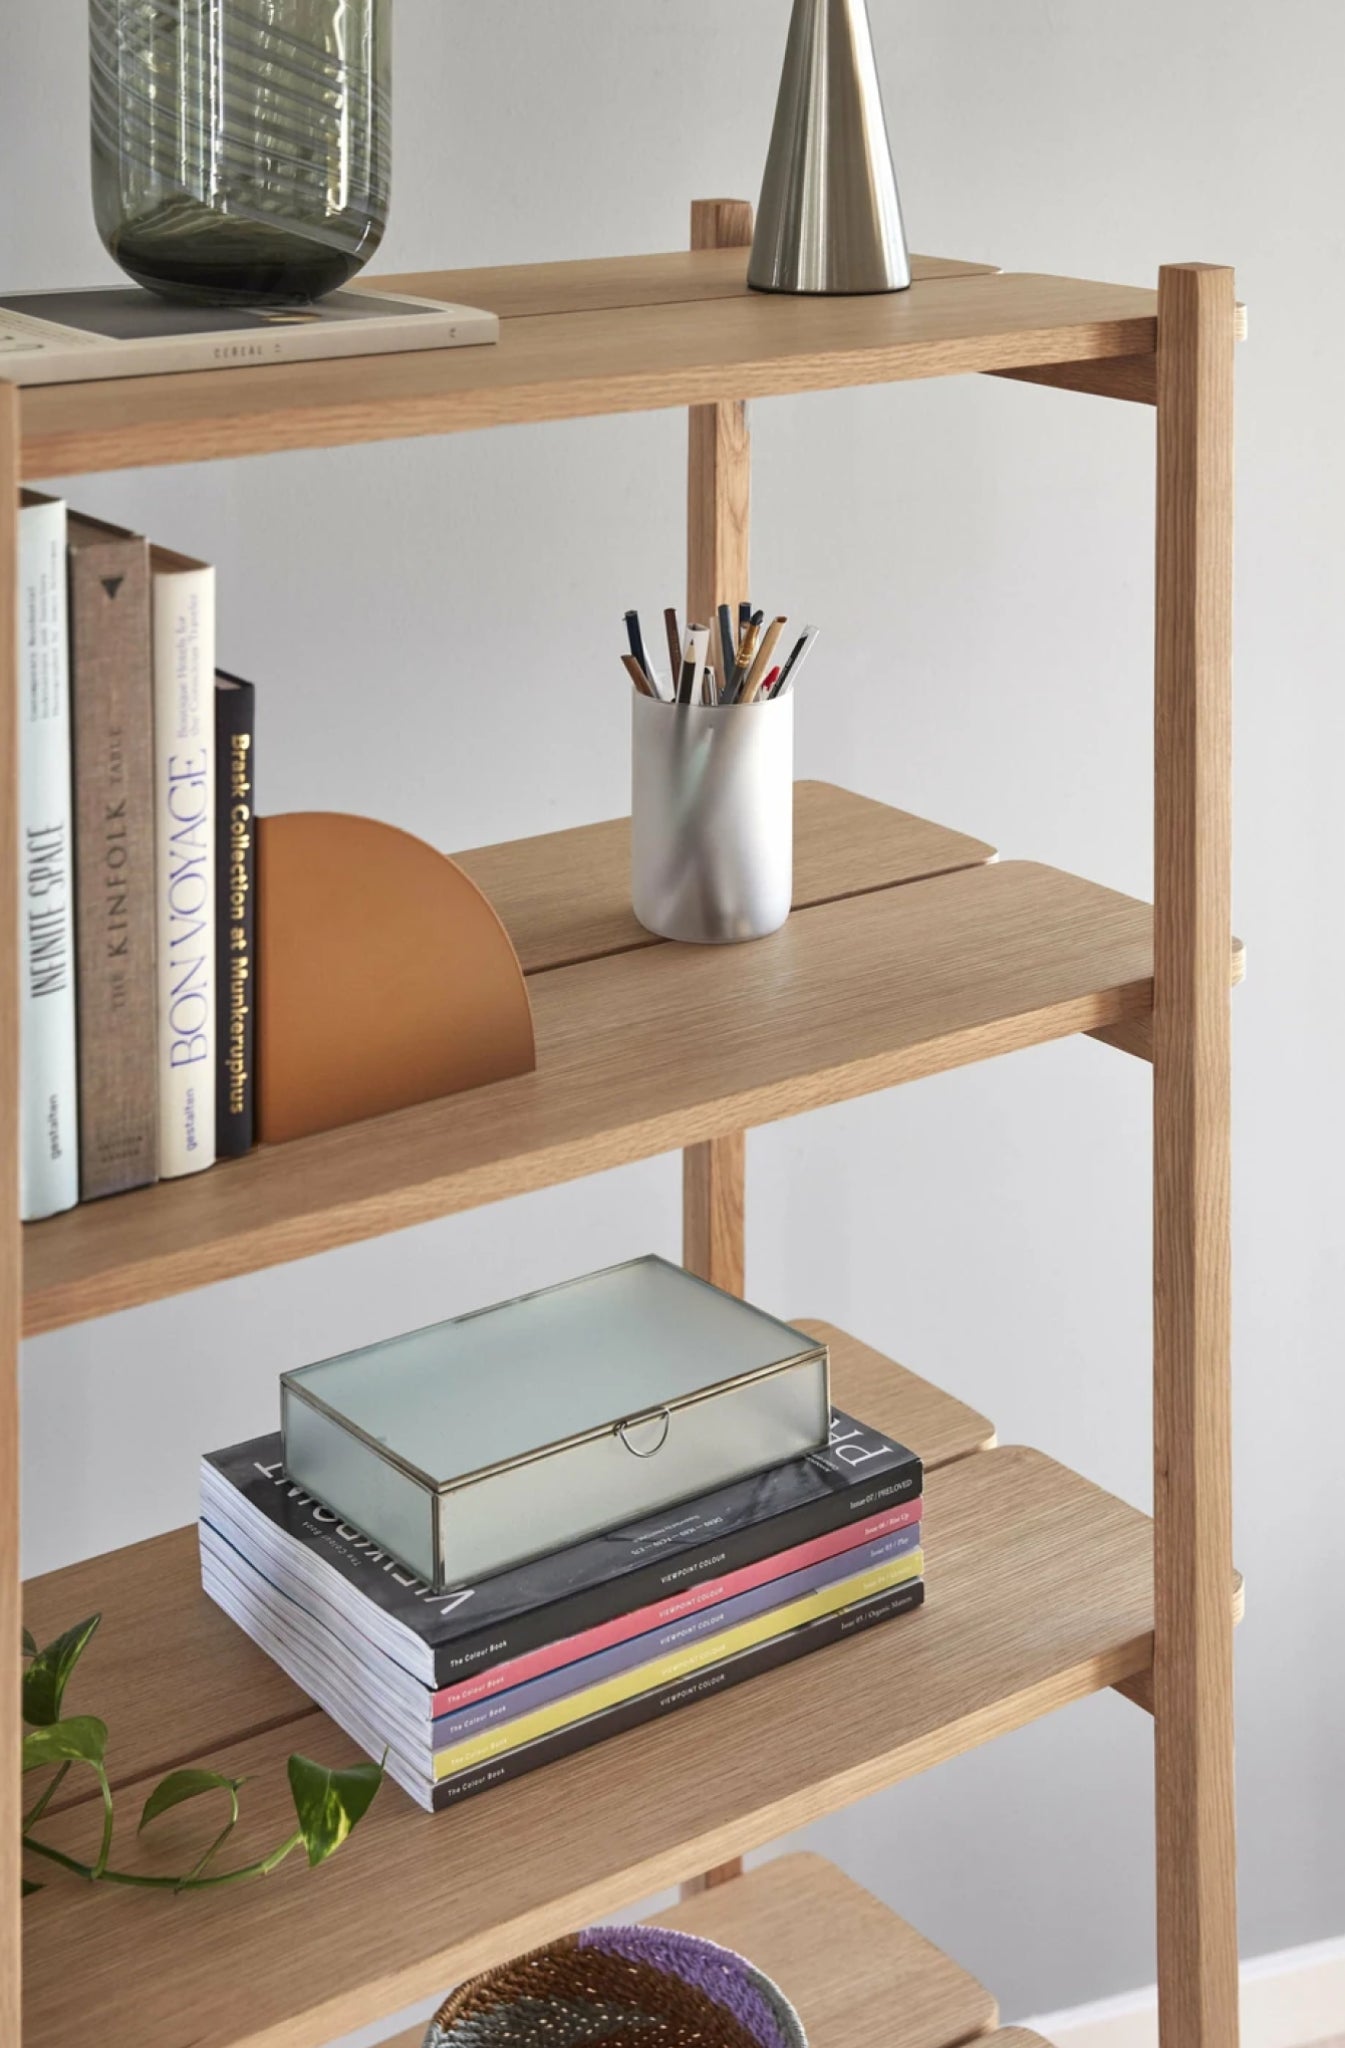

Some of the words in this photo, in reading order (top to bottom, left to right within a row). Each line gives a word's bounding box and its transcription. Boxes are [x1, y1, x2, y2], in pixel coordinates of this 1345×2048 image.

[108, 725, 125, 786] TABLE
[231, 734, 250, 798] Brask
[27, 820, 65, 898] SPACE
[168, 749, 208, 948] VOYAGE
[229, 804, 251, 920] Collection
[106, 799, 129, 958] KINFOLK
[29, 904, 68, 999] INFINITE
[229, 927, 247, 951] at
[111, 974, 127, 1010] THE
[169, 956, 208, 1068] BON
[223, 957, 249, 1114] Munkeruphus
[48, 1094, 62, 1160] gestalten
[185, 1088, 198, 1151] gestalten
[878, 1479, 913, 1498] PRELOVED
[661, 1563, 698, 1584] VIEWPOINT
[698, 1553, 726, 1569] COLOUR
[659, 1598, 697, 1618] VIEWPOINT
[696, 1587, 724, 1603] COLOUR
[660, 1624, 697, 1645] VIEWPOINT
[698, 1613, 725, 1630] COLOUR
[450, 1658, 463, 1668] The
[464, 1647, 489, 1662] Colour
[489, 1639, 507, 1652] Book
[447, 1695, 461, 1704] The
[461, 1684, 486, 1699] Colour
[486, 1676, 505, 1689] Book
[660, 1685, 698, 1706] VIEWPOINT
[698, 1673, 725, 1691] COLOUR
[450, 1725, 463, 1734] The
[463, 1714, 488, 1728] Colour
[489, 1705, 506, 1718] Book
[448, 1787, 461, 1797] The
[462, 1776, 486, 1791] Colour
[487, 1767, 505, 1780] Book
